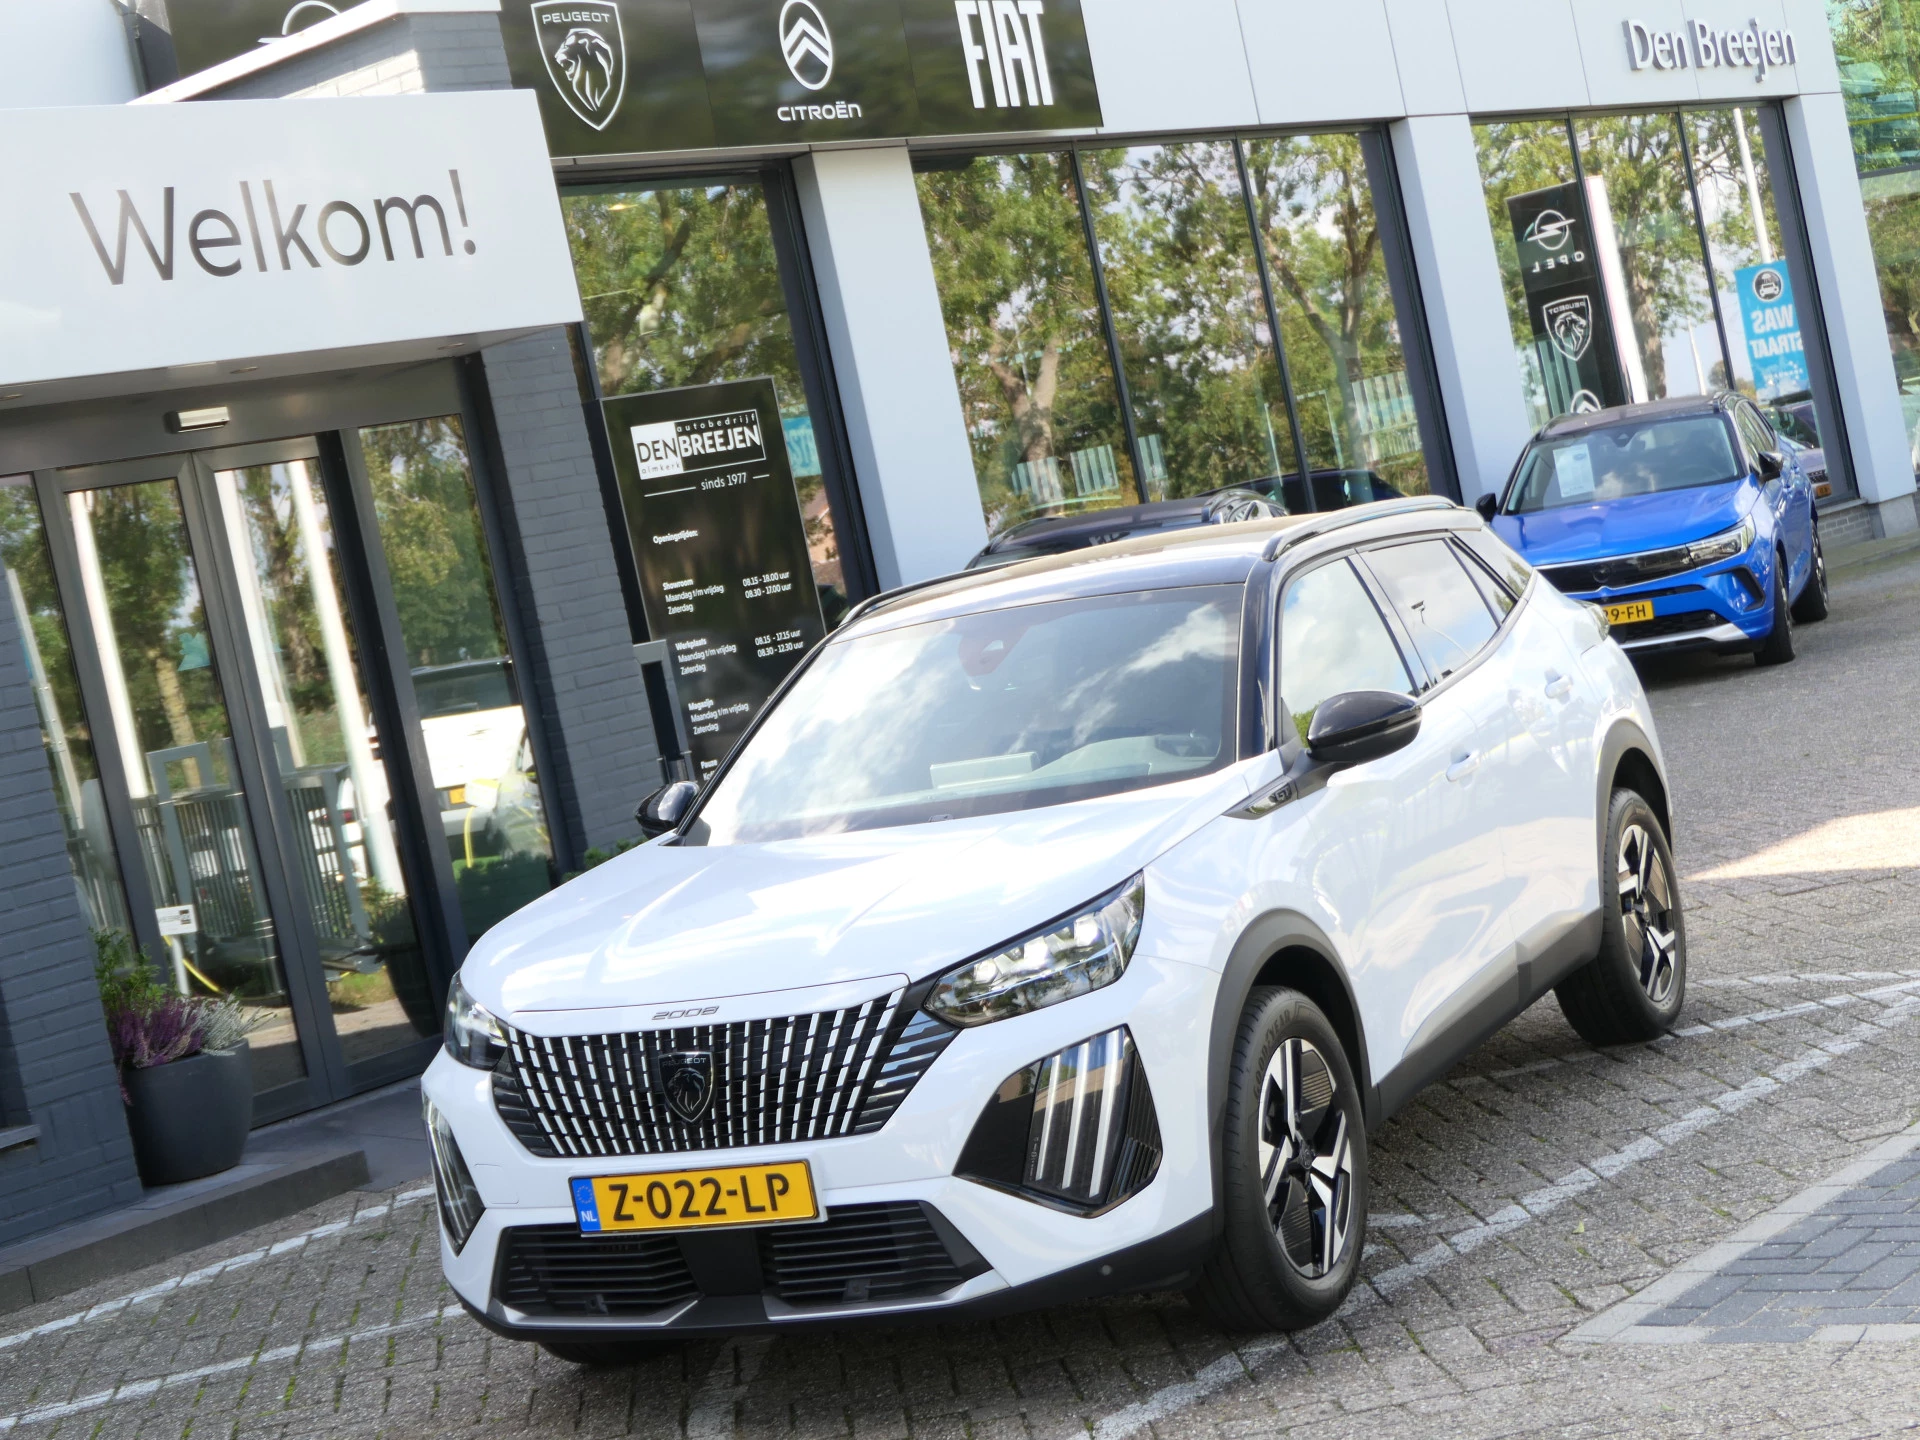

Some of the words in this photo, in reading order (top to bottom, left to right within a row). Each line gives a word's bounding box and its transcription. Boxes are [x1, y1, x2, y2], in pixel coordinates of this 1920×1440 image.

[541, 11, 611, 26] PEUGEOT
[955, 0, 1054, 109] FIAT
[1623, 18, 1690, 71] Den
[1688, 16, 1797, 83] Breejen
[68, 169, 478, 286] Welkom!
[676, 413, 756, 432] autobedrijf
[636, 437, 679, 463] DEN
[678, 425, 761, 457] BREEJEN
[641, 462, 681, 474] almkerk
[700, 478, 725, 491] sinds
[727, 472, 748, 487] 1977
[662, 579, 694, 591] Showroom
[665, 591, 693, 602] Maandag
[704, 585, 725, 596] vrijdag
[779, 571, 790, 580] uur
[667, 603, 694, 615] Zaterdag
[781, 583, 792, 592] uur
[678, 651, 706, 663] Maandag
[716, 644, 737, 655] vrijdag
[790, 629, 801, 638] uur
[680, 663, 707, 675] Zaterdag
[793, 641, 804, 650] uur
[690, 710, 718, 723] Maandag
[728, 703, 750, 714] vrijdag
[693, 723, 720, 735] Zaterdag
[651, 1005, 720, 1021] 2008
[581, 1210, 597, 1223] NL
[608, 1172, 790, 1222] Z-022-LP
